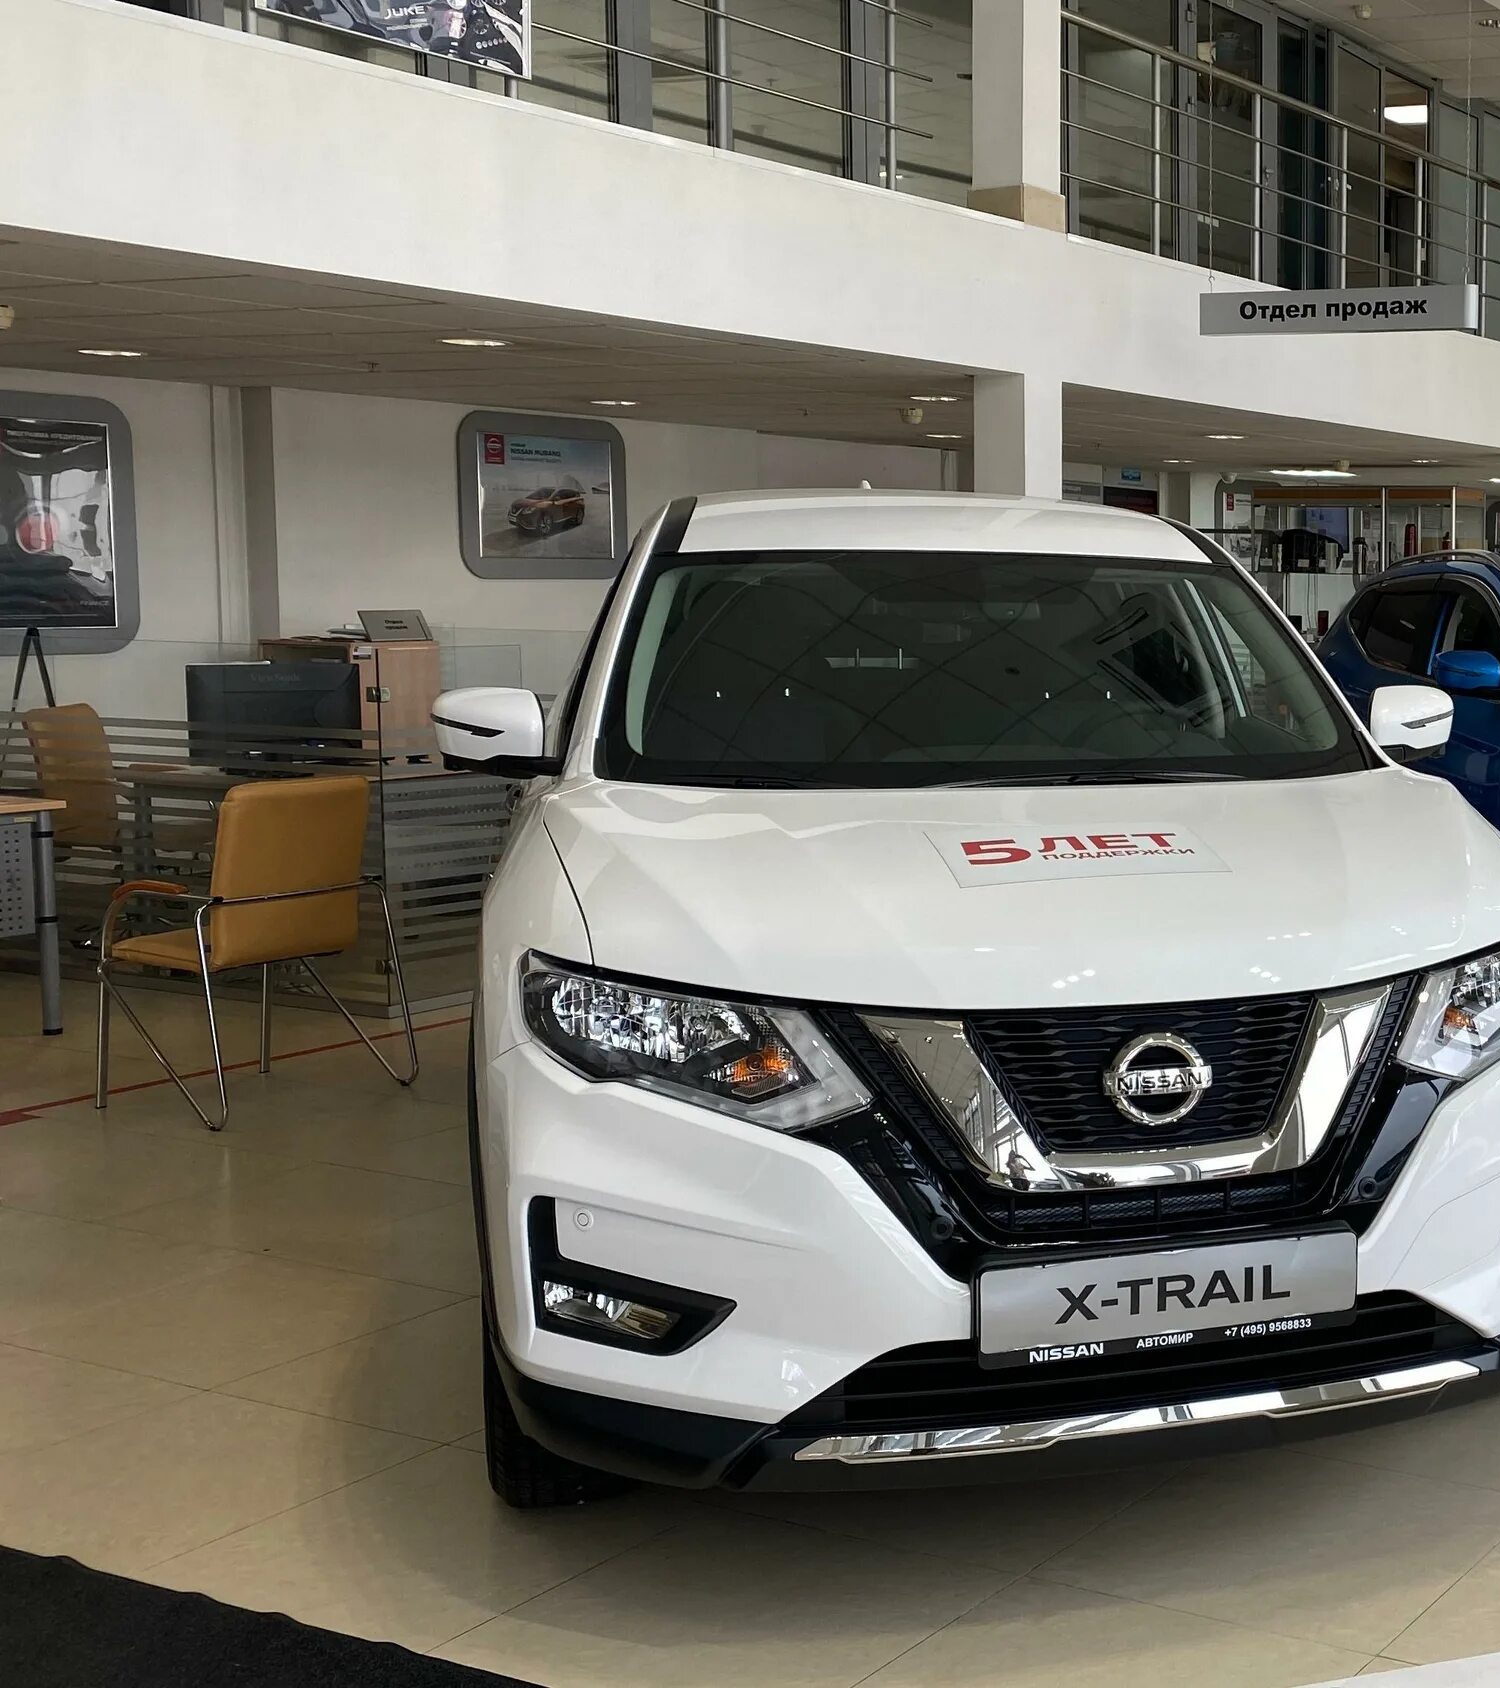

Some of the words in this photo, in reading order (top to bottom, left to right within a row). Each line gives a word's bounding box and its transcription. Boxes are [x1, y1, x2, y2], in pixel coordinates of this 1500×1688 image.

[384, 5, 426, 20] JUKE
[1239, 299, 1317, 322] Отдел
[1325, 297, 1428, 321] продаж
[960, 838, 1032, 866] 5
[1036, 832, 1177, 853] ЛЕТ
[1041, 848, 1196, 861] ПОДДЕРЖКИ
[1116, 1072, 1203, 1092] NISSAN
[1055, 1264, 1291, 1325] X-TRAIL
[1224, 1327, 1239, 1338] +7
[1240, 1323, 1267, 1338] (495)
[1269, 1318, 1312, 1334] 9568833
[1136, 1332, 1194, 1349] АВТОМИР
[1029, 1343, 1104, 1363] NISSAN
